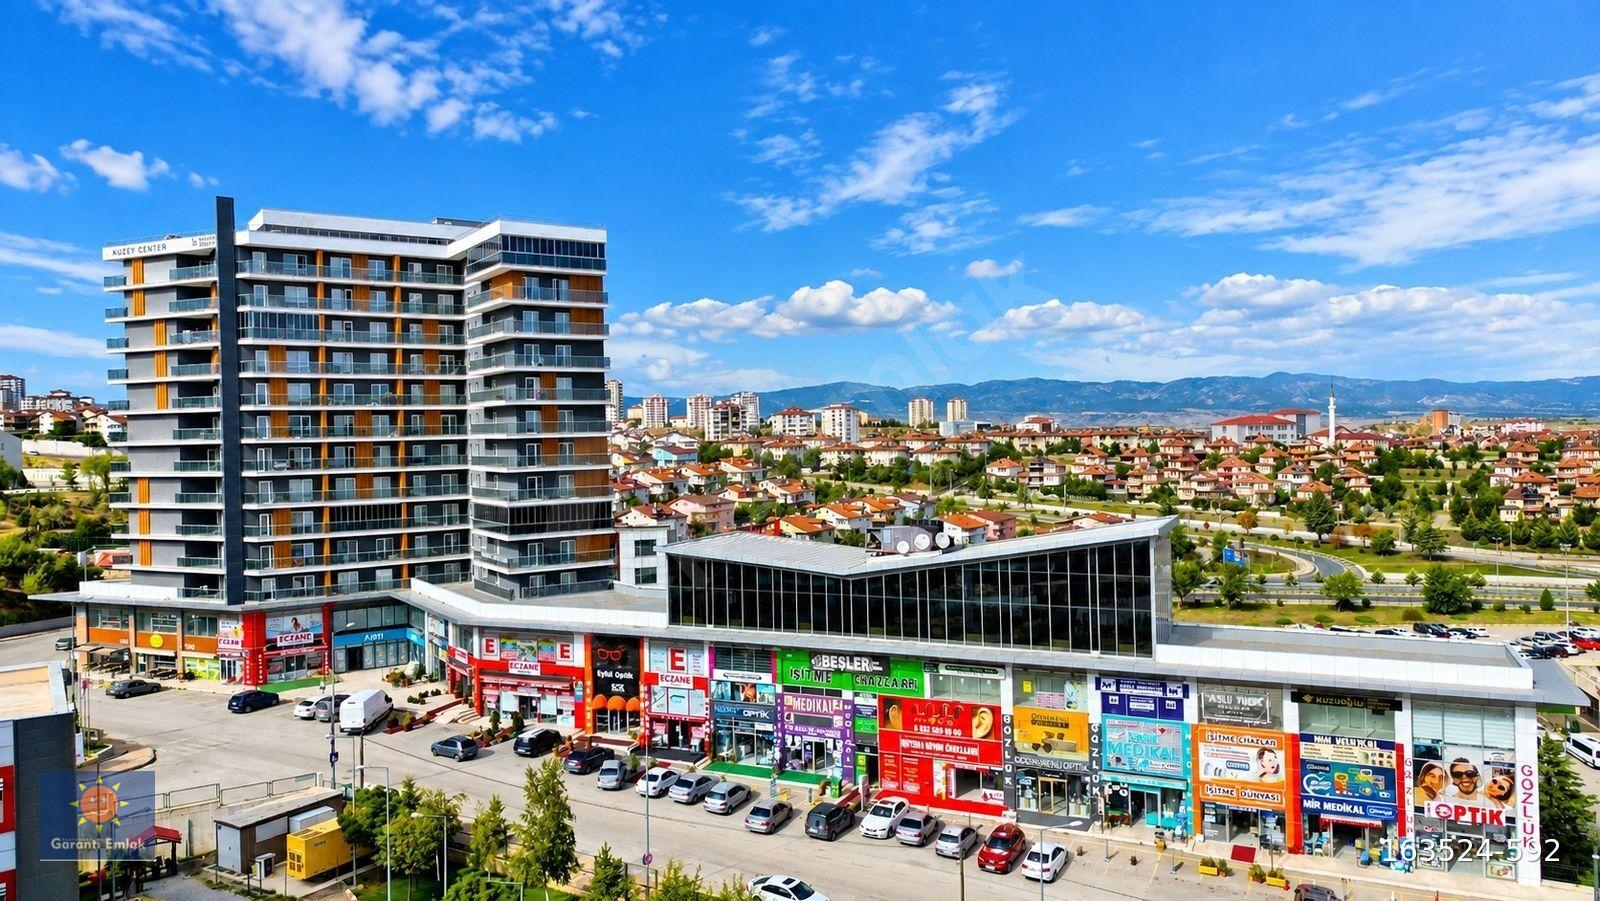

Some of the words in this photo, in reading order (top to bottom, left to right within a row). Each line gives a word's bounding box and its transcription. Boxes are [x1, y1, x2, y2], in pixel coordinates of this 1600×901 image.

[112, 247, 135, 256] KUZEY
[138, 243, 167, 254] CENTER
[485, 638, 495, 654] E
[560, 643, 570, 659] E
[670, 648, 685, 671] E
[660, 674, 691, 685] ECZANE
[1302, 798, 1321, 810] MİR
[1323, 802, 1365, 815] MEDİKAL
